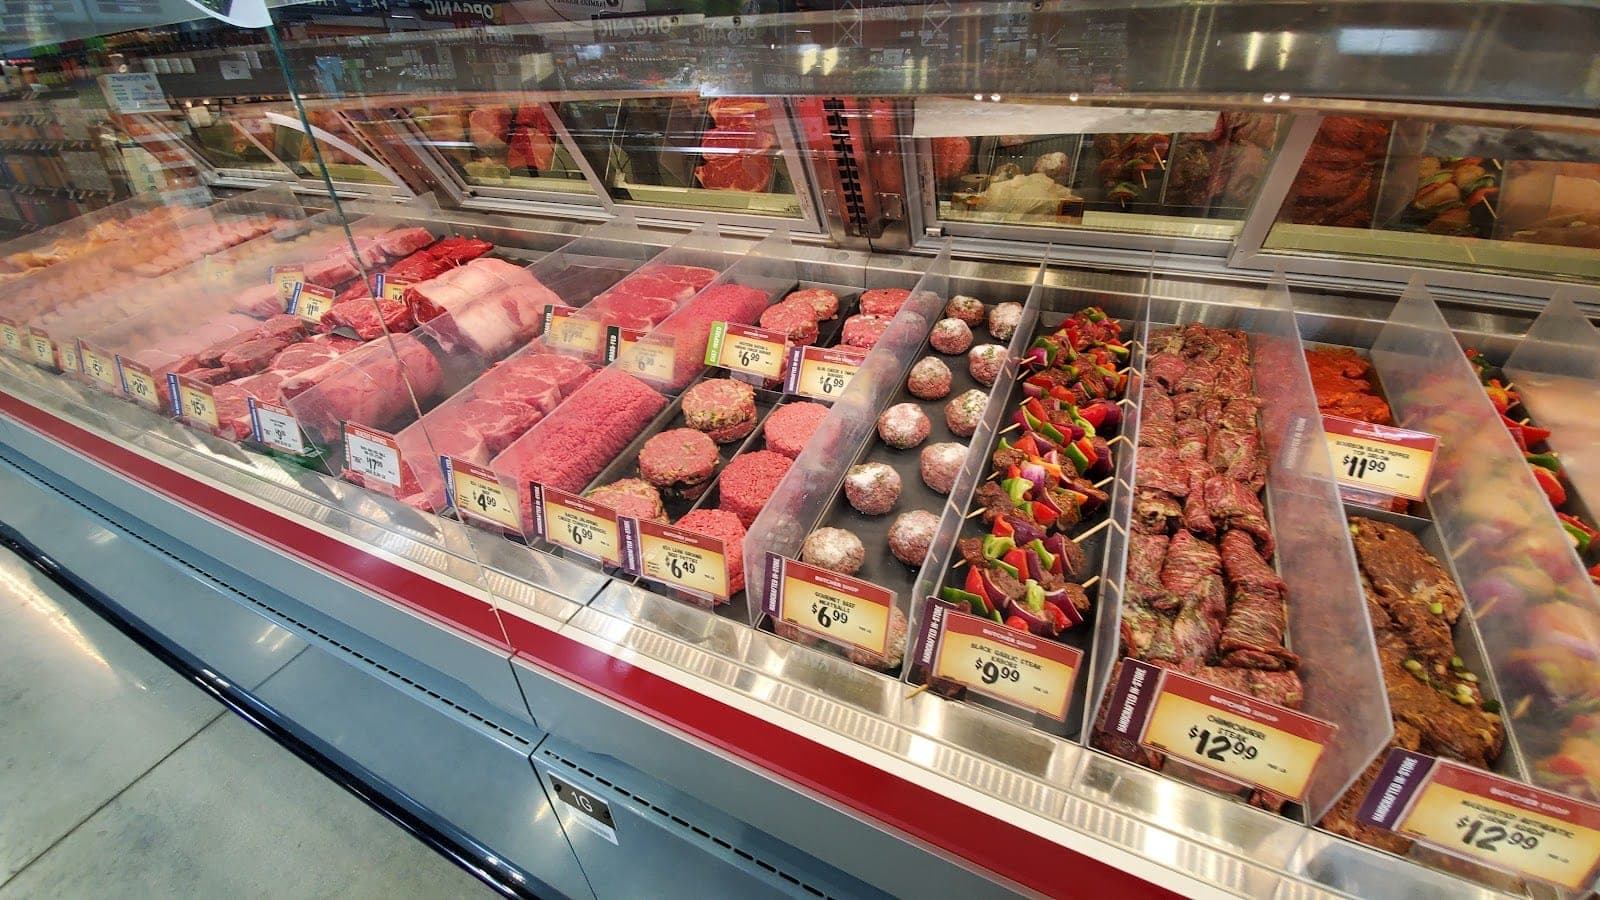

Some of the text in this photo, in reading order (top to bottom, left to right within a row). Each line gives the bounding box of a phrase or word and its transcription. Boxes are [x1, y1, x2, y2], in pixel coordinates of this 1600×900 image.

[922, 604, 944, 664] HANDCRAFTED IN-STORE
[970, 642, 1042, 671] BLACK GARLIC STEAK
[1116, 667, 1147, 734] HANDCRAFTED IN-STORE
[1207, 714, 1267, 741] CHIMICHURRI
[1217, 727, 1248, 744] STEAK
[1371, 756, 1418, 823] HANDCRAFTED IN-STORE
